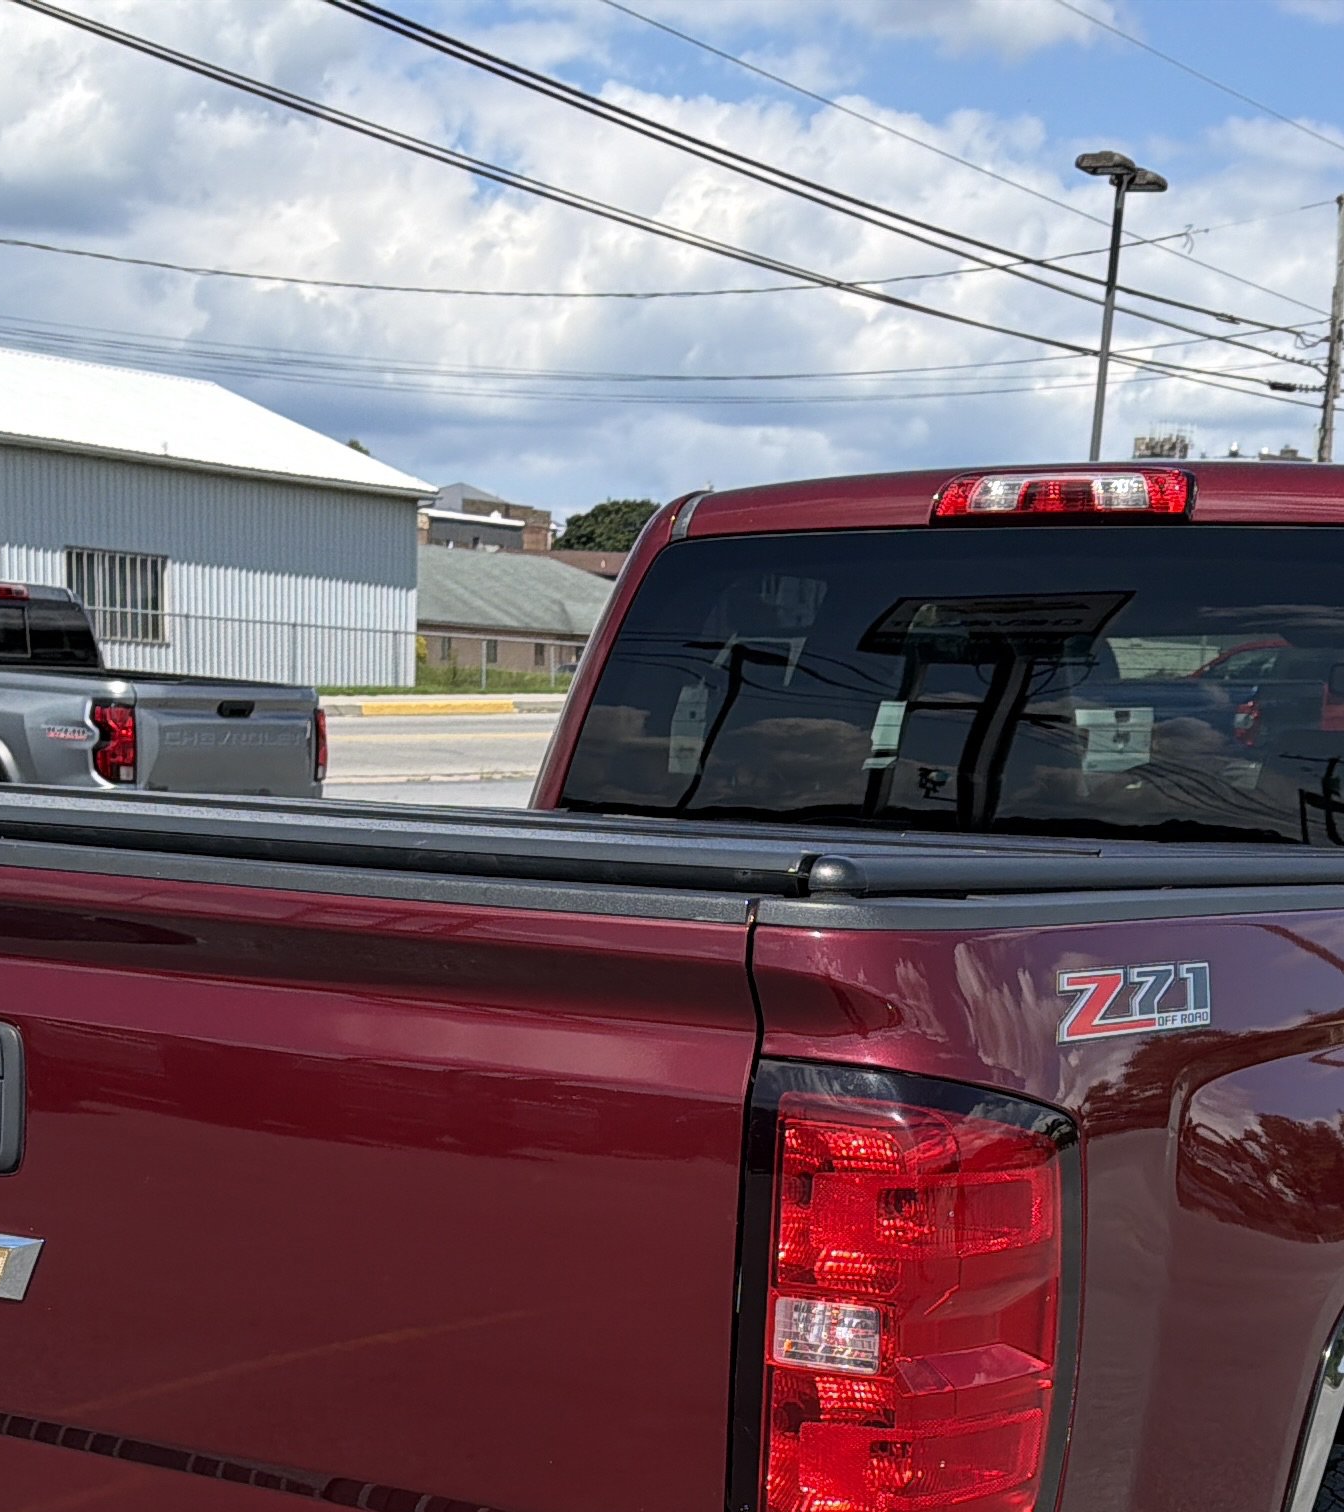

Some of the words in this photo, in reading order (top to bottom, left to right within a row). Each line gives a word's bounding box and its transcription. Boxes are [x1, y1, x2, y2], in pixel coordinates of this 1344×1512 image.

[1056, 961, 1211, 1046] Z71
[1157, 1014, 1178, 1027] OFF
[1180, 1011, 1209, 1024] ROAD
